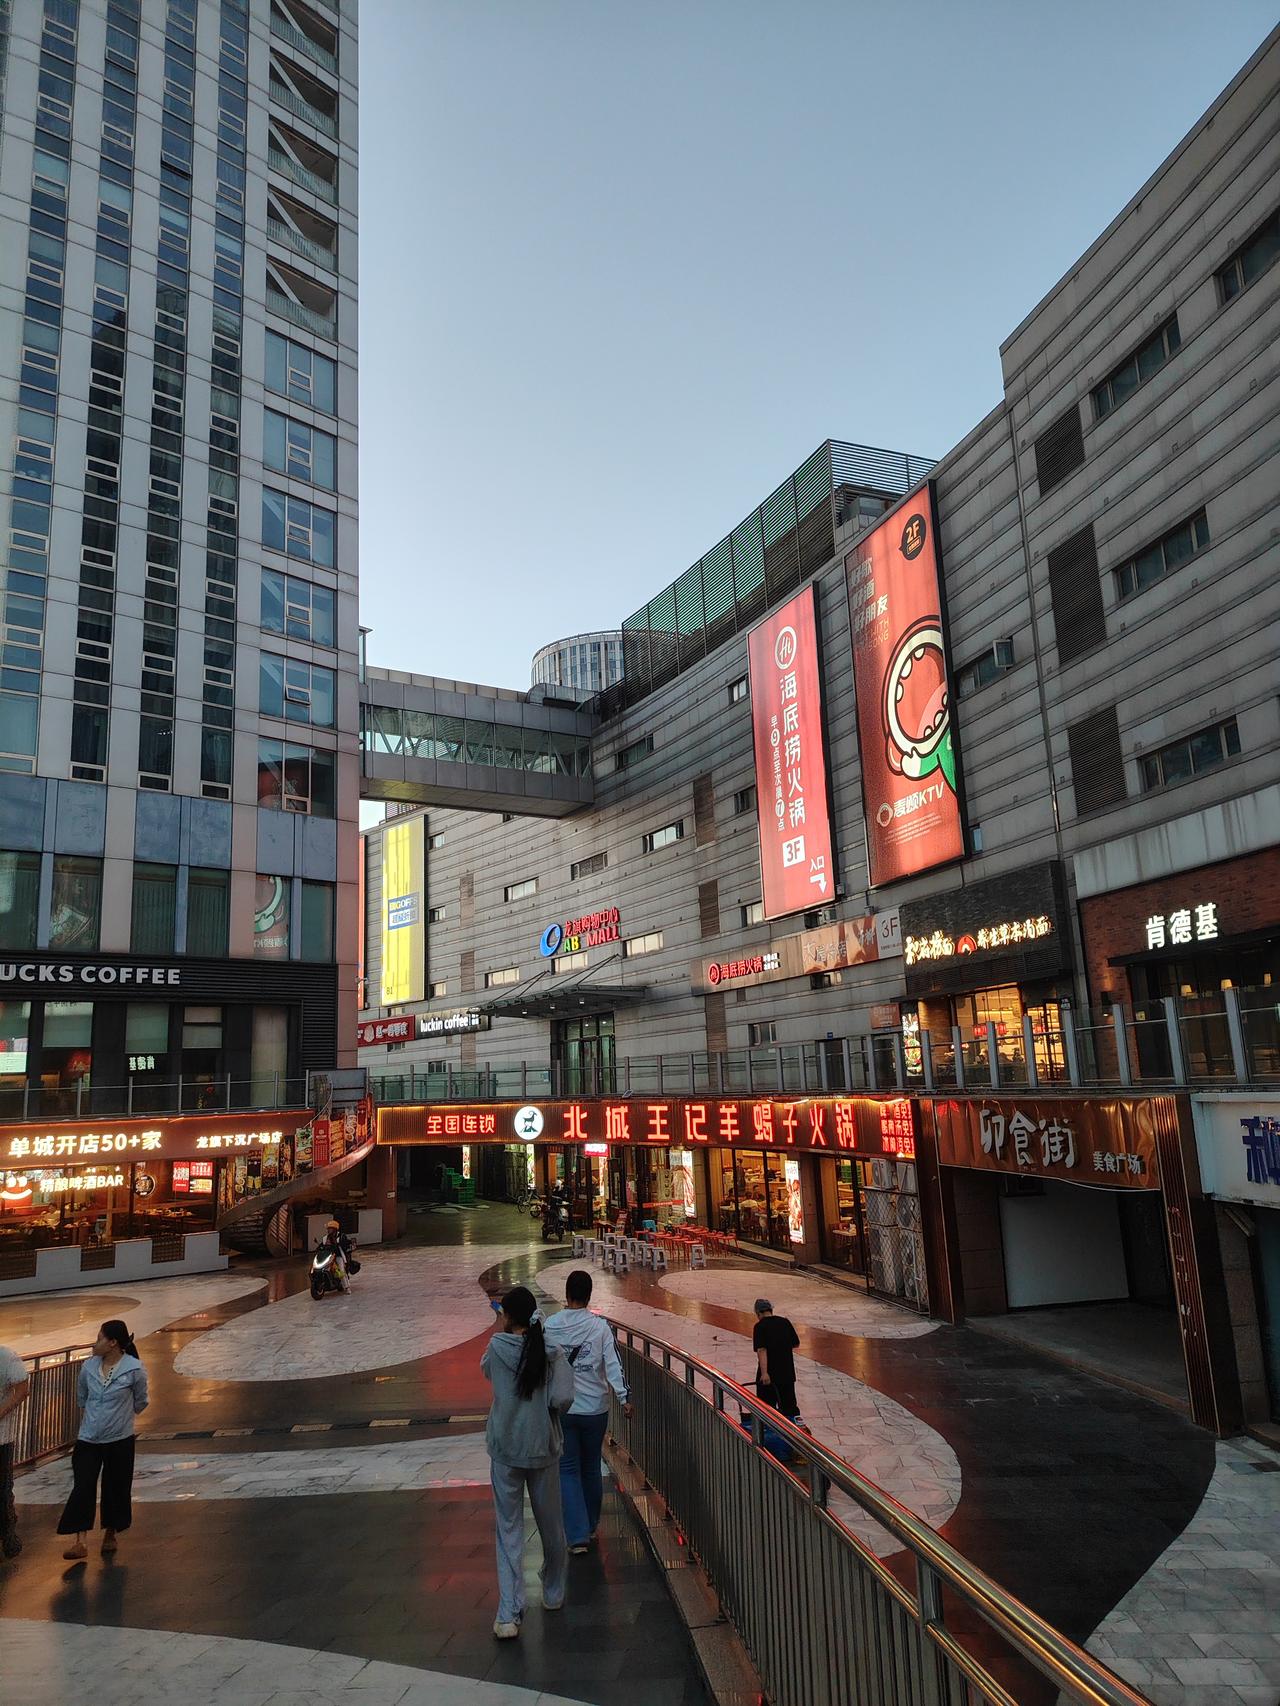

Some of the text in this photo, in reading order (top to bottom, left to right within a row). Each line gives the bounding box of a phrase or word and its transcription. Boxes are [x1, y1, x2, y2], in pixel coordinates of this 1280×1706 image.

[906, 520, 920, 544] 2F
[854, 594, 888, 632] 好朋友
[779, 670, 806, 829] 海底捞火锅
[786, 840, 801, 863] 3F
[810, 855, 825, 872] 入口
[881, 917, 898, 938] 3F
[1145, 902, 1219, 950] 肯德基
[563, 925, 620, 953] AB MALL
[0, 964, 181, 985] UCKS COFFEE
[720, 956, 763, 980] 海底捞火锅
[420, 1016, 443, 1033] luckin
[444, 1012, 468, 1030] coffee
[427, 1114, 496, 1135] 全国连锁
[563, 1103, 856, 1149] 北城王记羊蝎子火锅
[8, 1131, 162, 1158] 单城开店50+家
[196, 1131, 283, 1149] 龙旗下沉广场店
[1093, 1150, 1141, 1175] 美食广场
[39, 1174, 124, 1193] 精酿啤酒BAR
